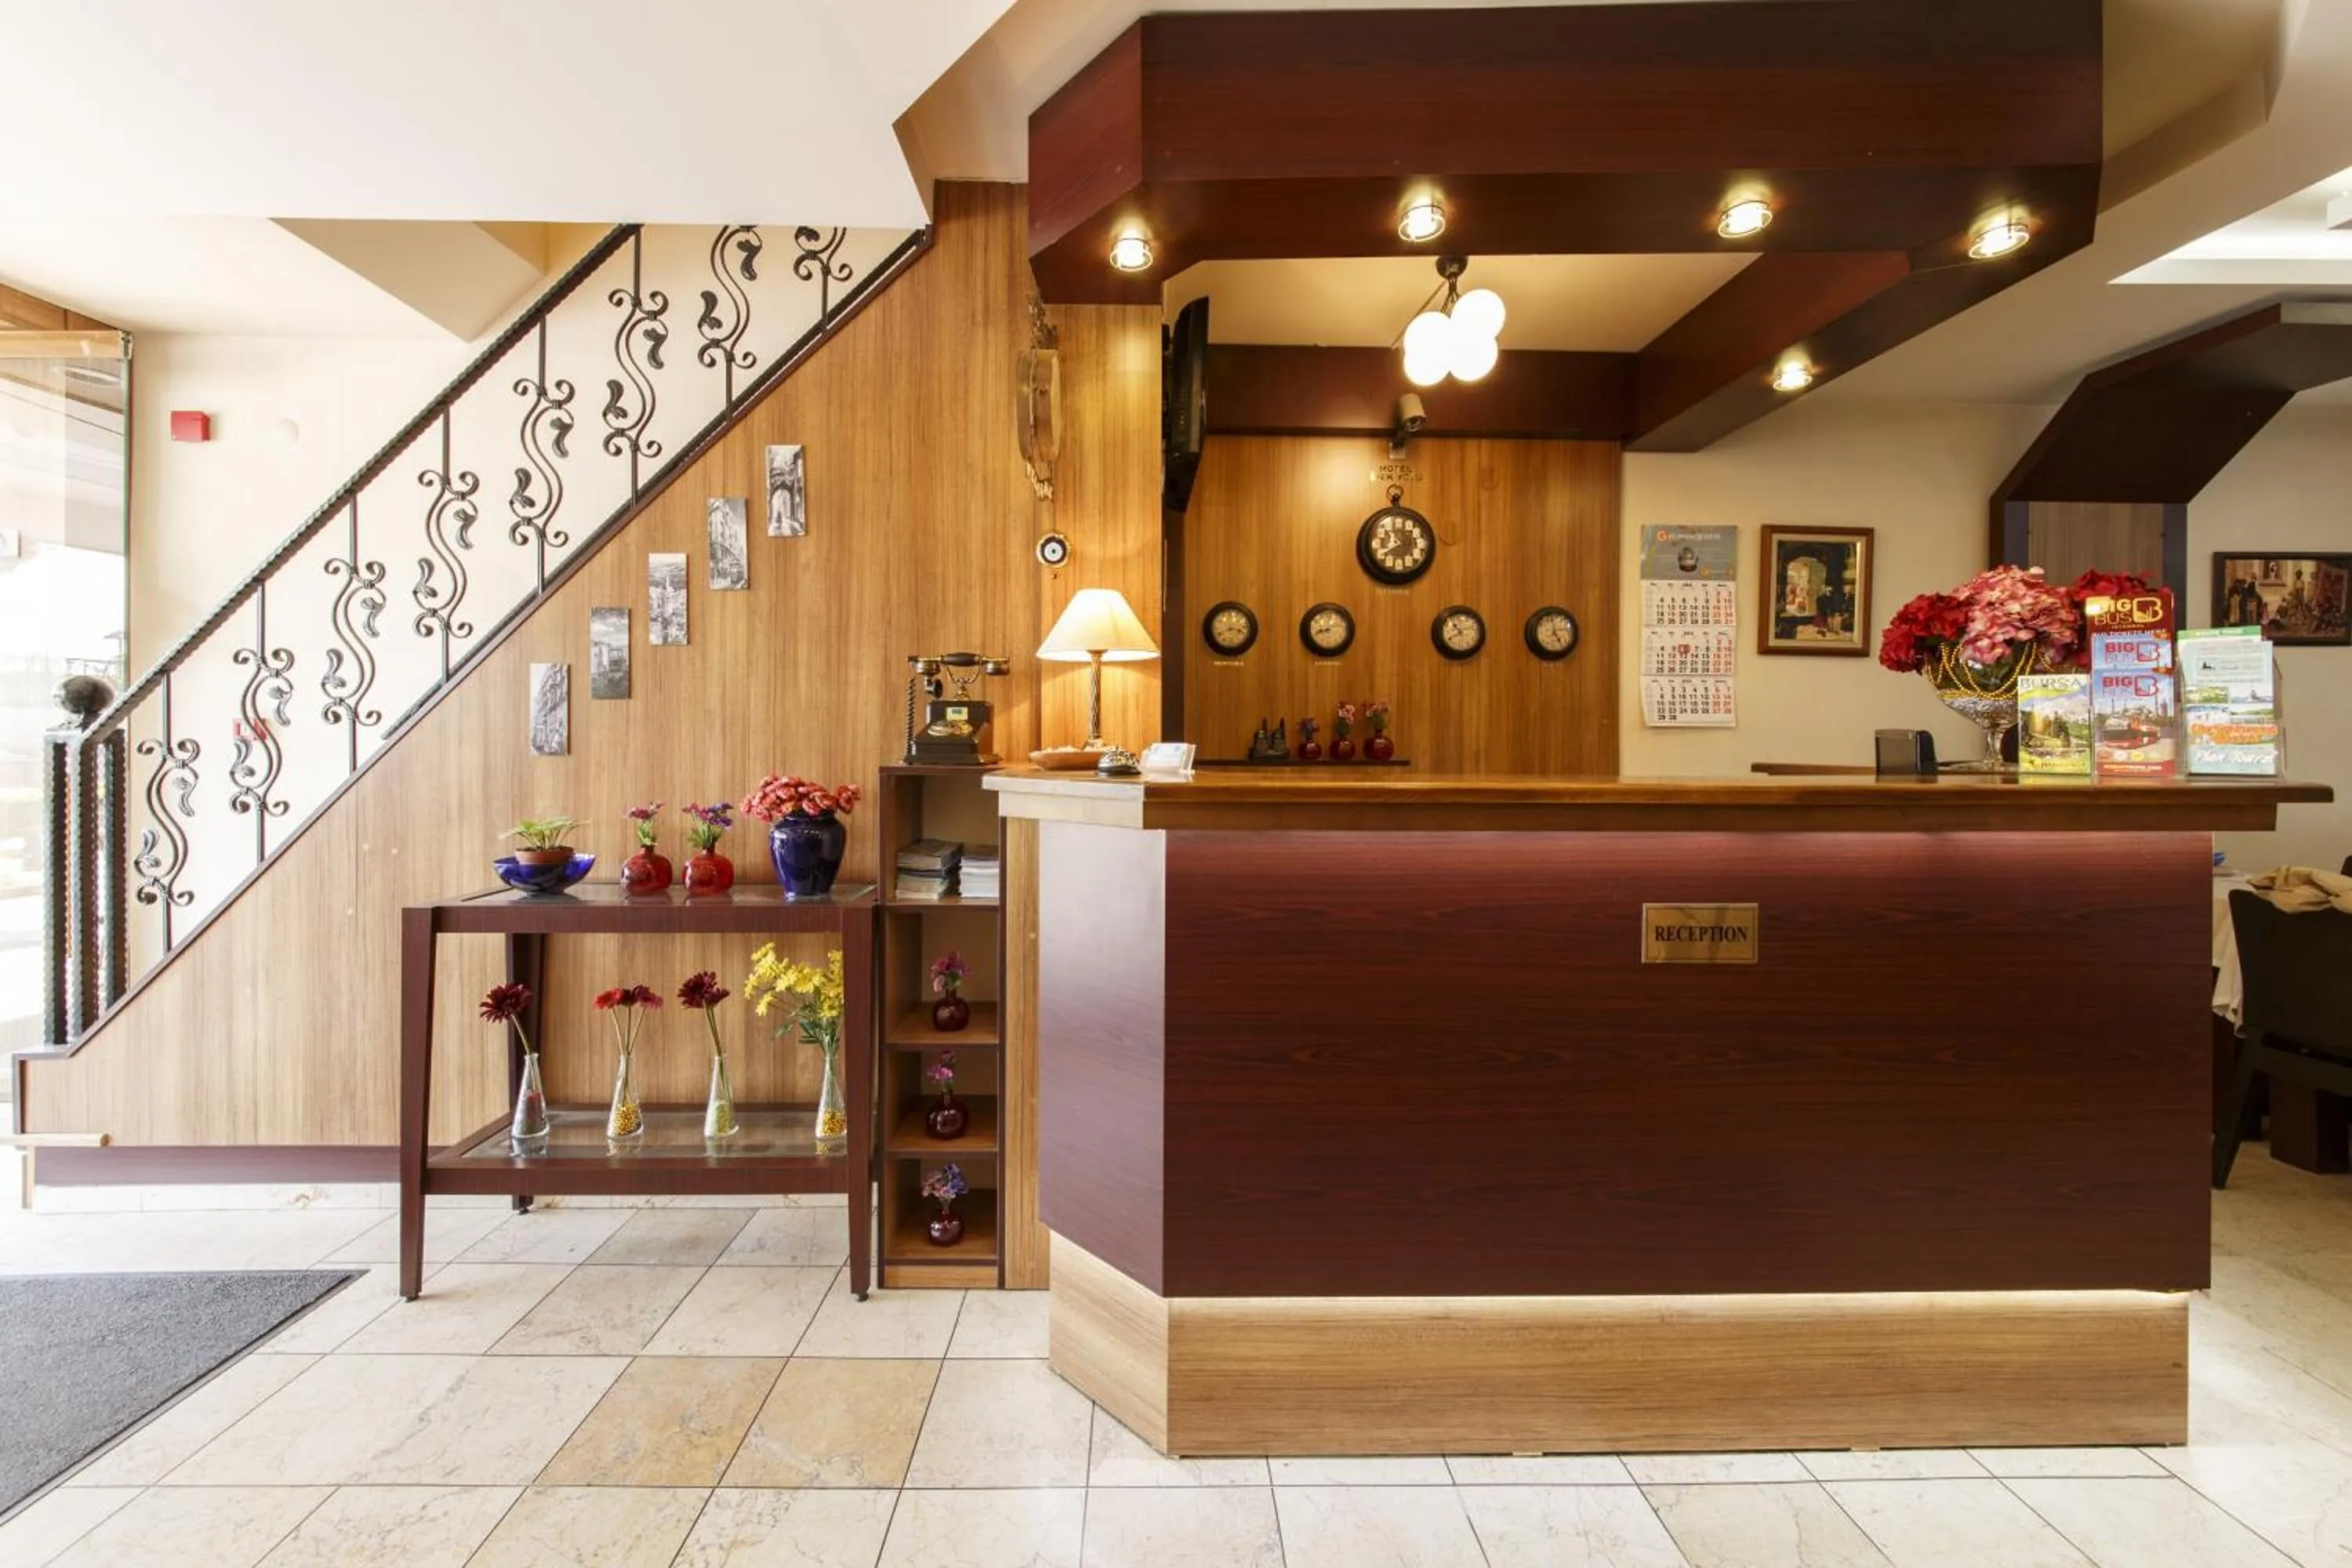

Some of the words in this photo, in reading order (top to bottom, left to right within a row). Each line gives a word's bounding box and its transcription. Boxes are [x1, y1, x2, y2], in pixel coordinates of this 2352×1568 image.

[1380, 465, 1412, 474] HOTEL
[2107, 642, 2134, 653] BIG
[2020, 677, 2083, 691] BURSA
[2102, 677, 2132, 687] BIG
[1654, 925, 1748, 942] RECEPTION
